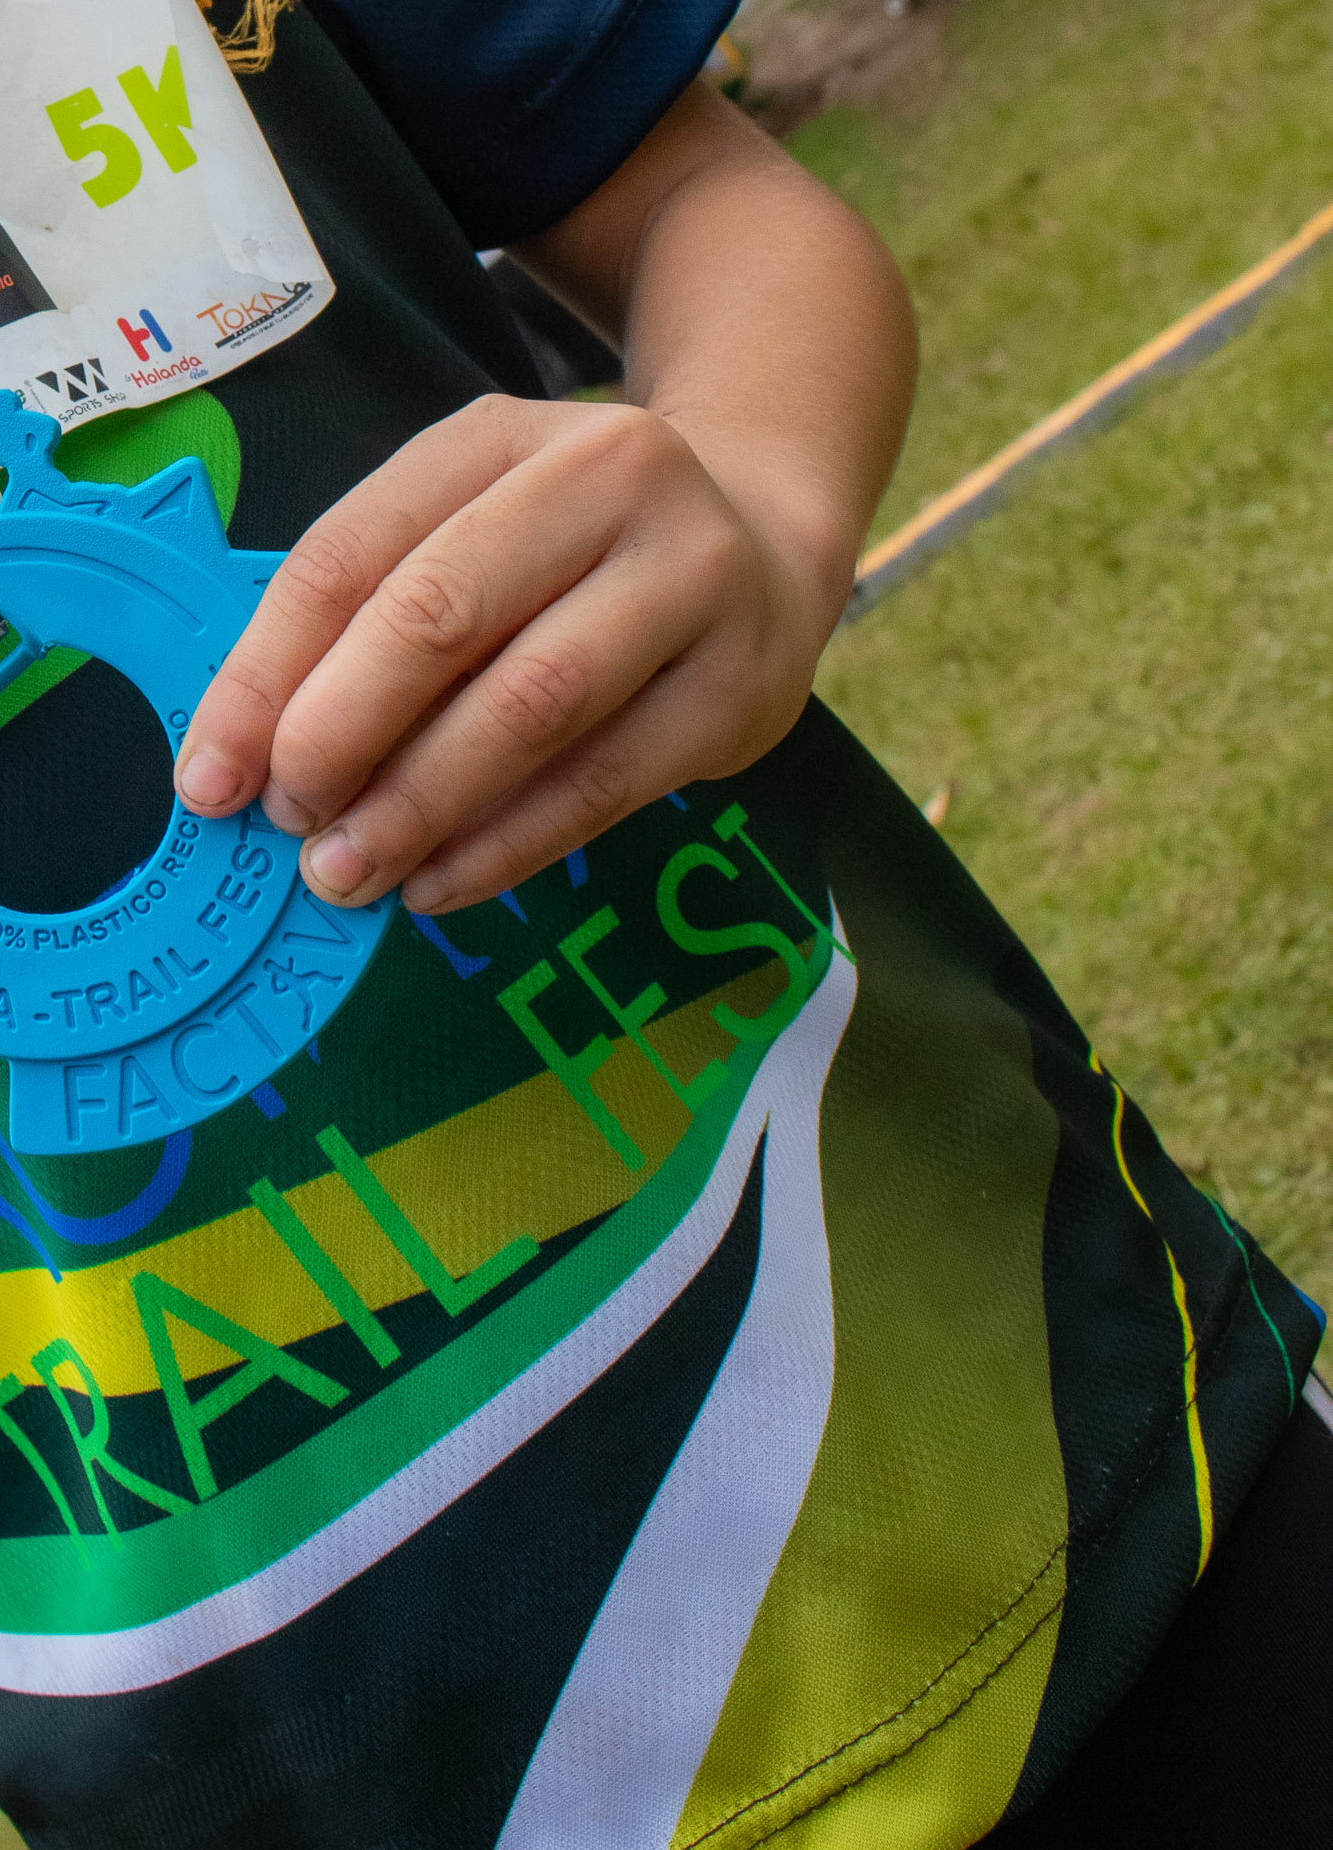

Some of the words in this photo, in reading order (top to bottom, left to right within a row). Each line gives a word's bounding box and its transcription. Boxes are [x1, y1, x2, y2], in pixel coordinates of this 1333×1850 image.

[45, 45, 198, 209] 5K
[58, 398, 102, 423] SPORTS
[130, 356, 203, 389] Holanda
[33, 879, 167, 951] PLASTICO
[197, 810, 283, 947] FEST
[496, 802, 857, 1174] FEST
